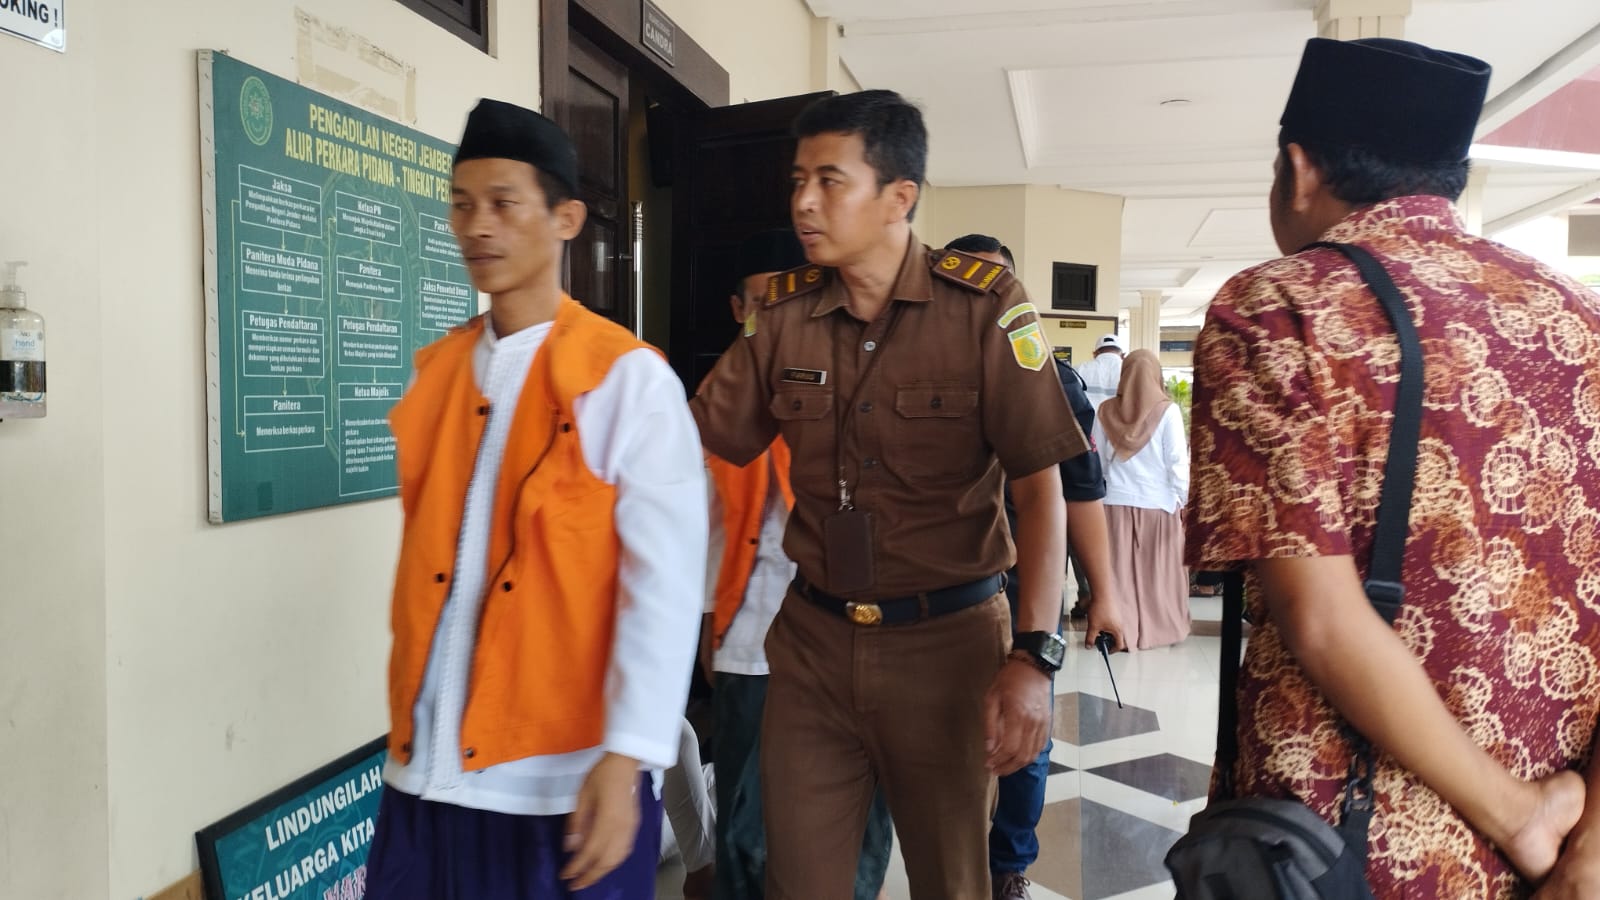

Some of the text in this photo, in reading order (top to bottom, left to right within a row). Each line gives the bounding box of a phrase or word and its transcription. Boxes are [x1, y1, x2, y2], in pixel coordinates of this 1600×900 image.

[646, 23, 672, 56] CANDRA
[310, 104, 380, 150] PENGADILAN
[382, 130, 417, 164] NEGERI
[418, 144, 453, 176] JEMBER
[285, 128, 313, 163] ALUR
[316, 138, 360, 178] PERKARA
[362, 153, 395, 187] PIDANA
[402, 166, 434, 198] TINGKAT
[272, 178, 292, 194] Jaksa
[358, 200, 374, 214] Ketua
[246, 248, 318, 270] Panitera Muda Pidana
[360, 263, 381, 276] Panitera
[424, 281, 436, 292] Jaksa
[250, 314, 318, 331] Petugas Pendaftaran
[343, 319, 398, 334] Petugas Pendaftaran
[355, 386, 389, 398] Ketua Majelis
[273, 400, 301, 411] Panitera
[256, 426, 282, 436] Memeriksa
[264, 766, 382, 851] LINDUNGILAH
[236, 816, 375, 900] ELUARGA KITA
